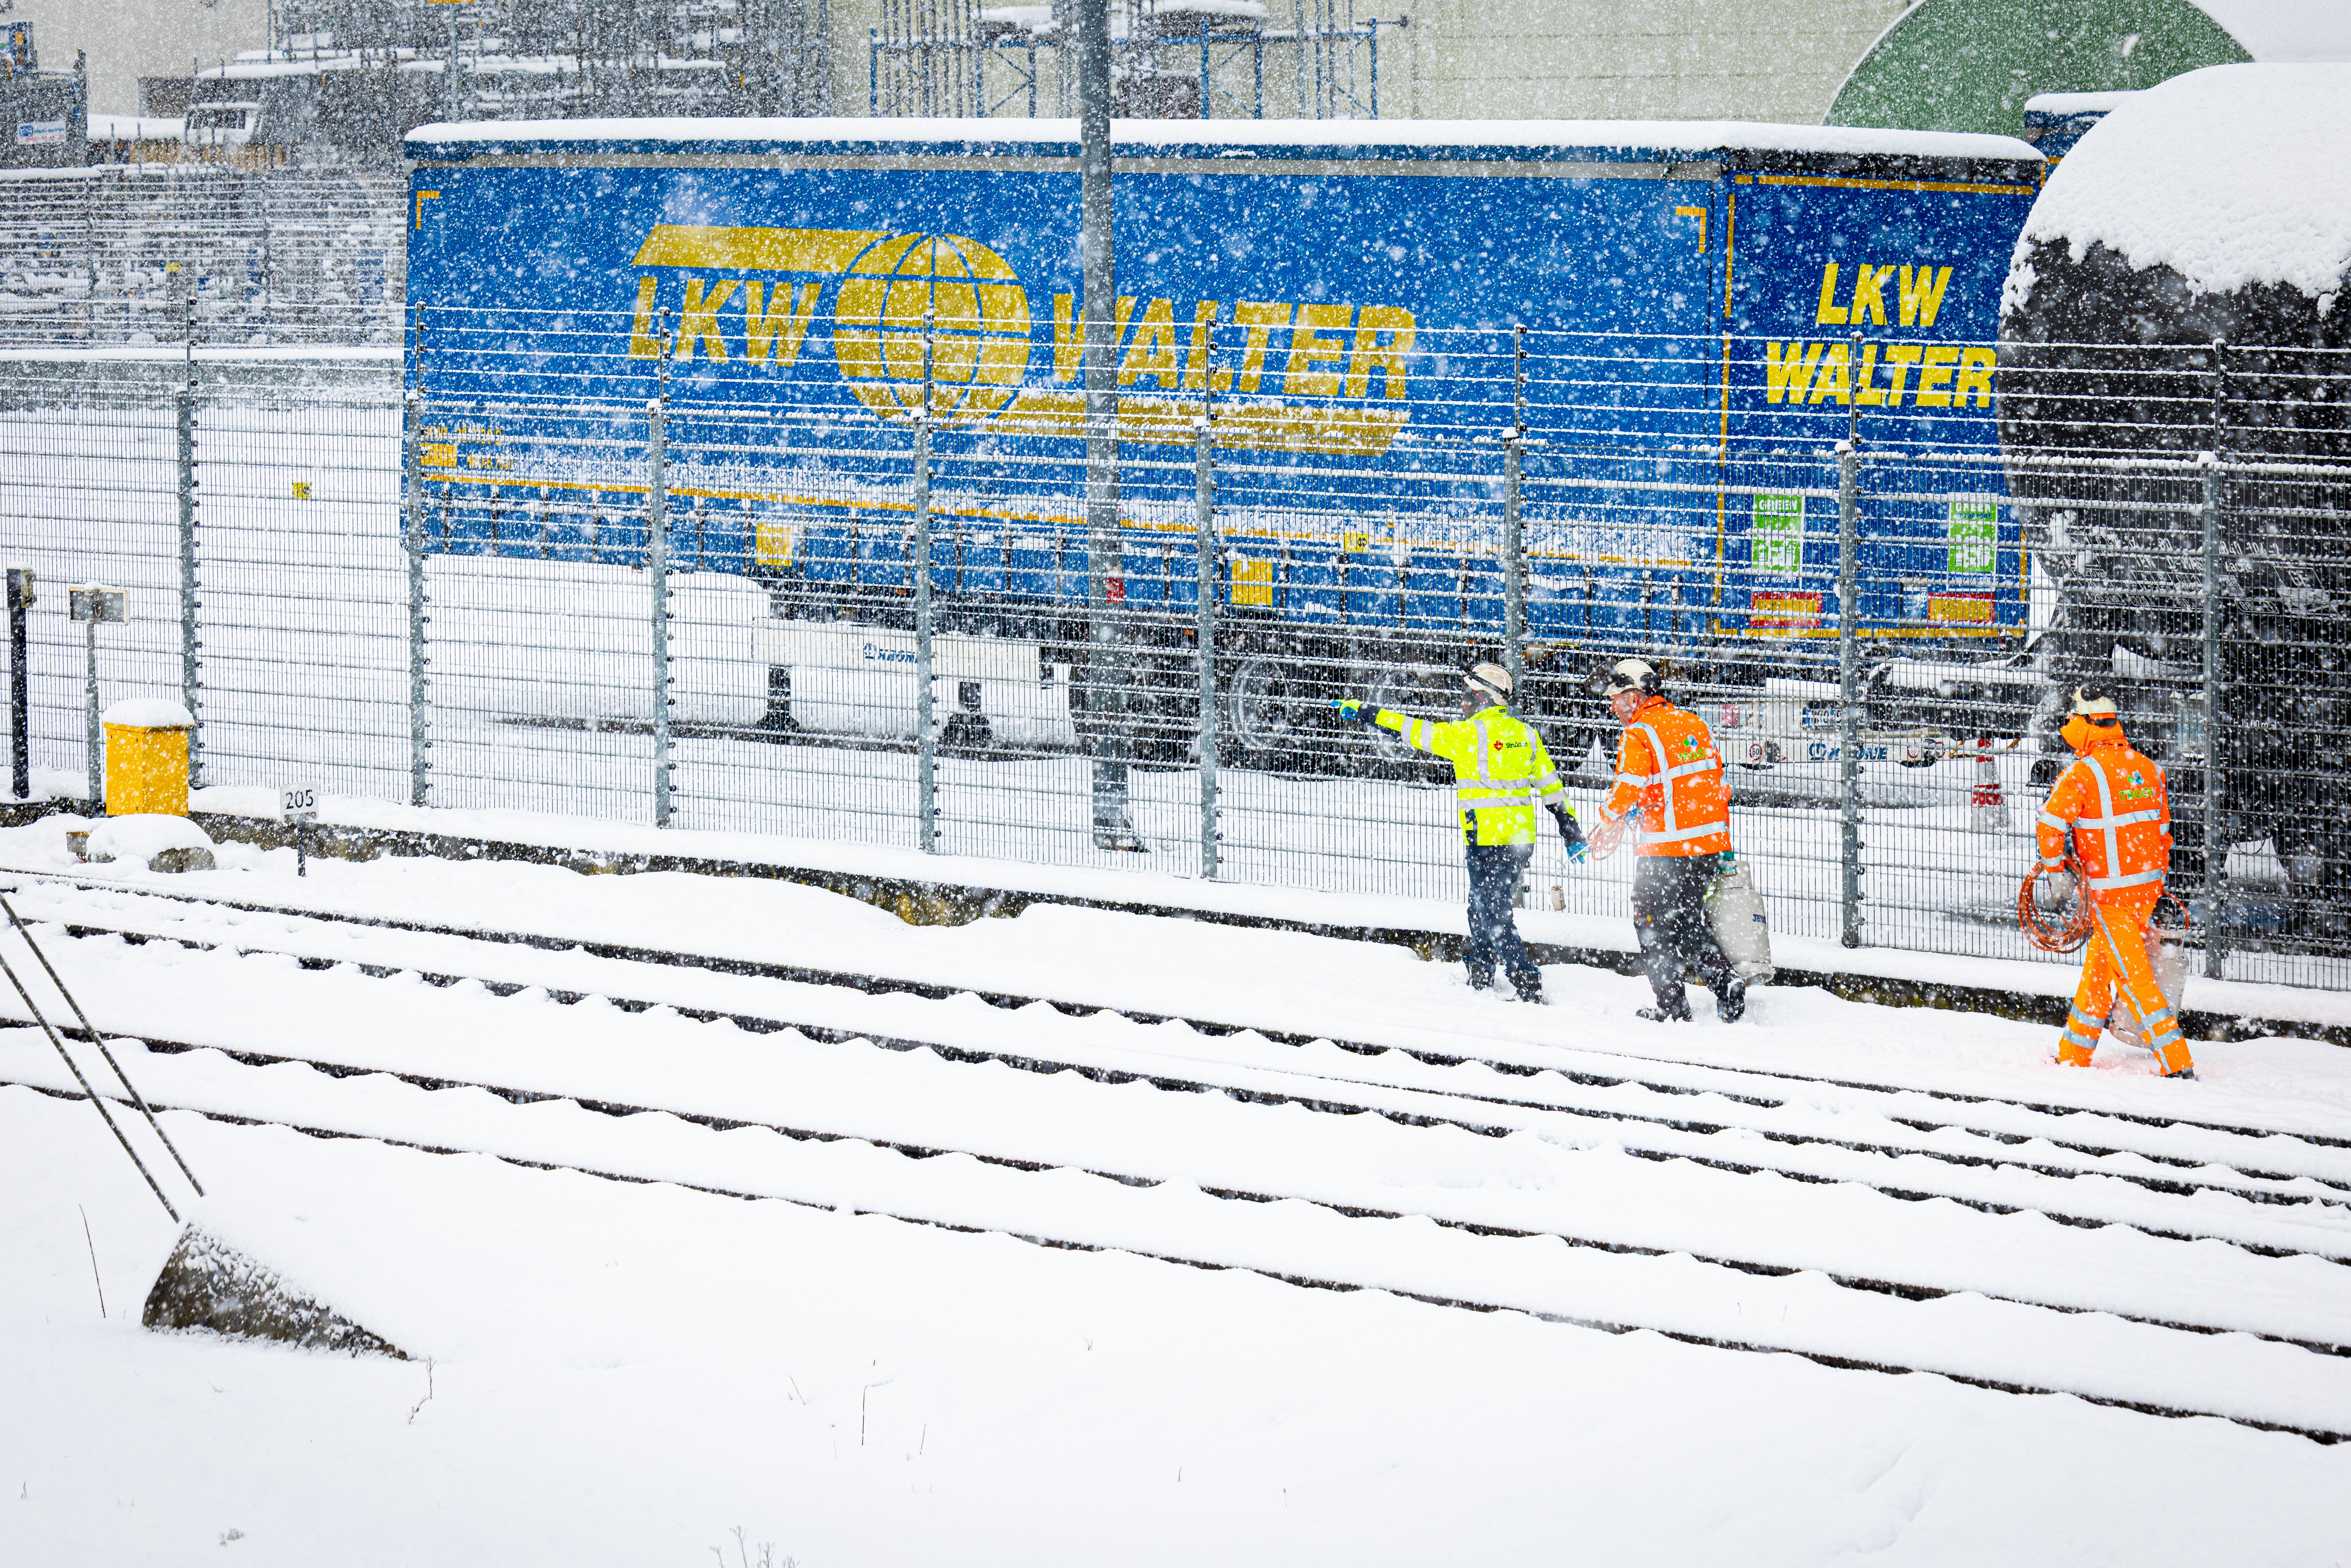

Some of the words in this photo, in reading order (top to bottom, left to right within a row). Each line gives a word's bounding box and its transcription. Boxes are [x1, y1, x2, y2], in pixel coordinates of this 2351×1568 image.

[1816, 263, 1953, 327] LKW
[629, 277, 822, 366] LKW
[1054, 294, 1416, 400] WALTER
[1766, 342, 1996, 407] WALTER
[1759, 499, 1797, 511] GREEN
[1829, 747, 1888, 760] KONE
[286, 789, 313, 809] 205
